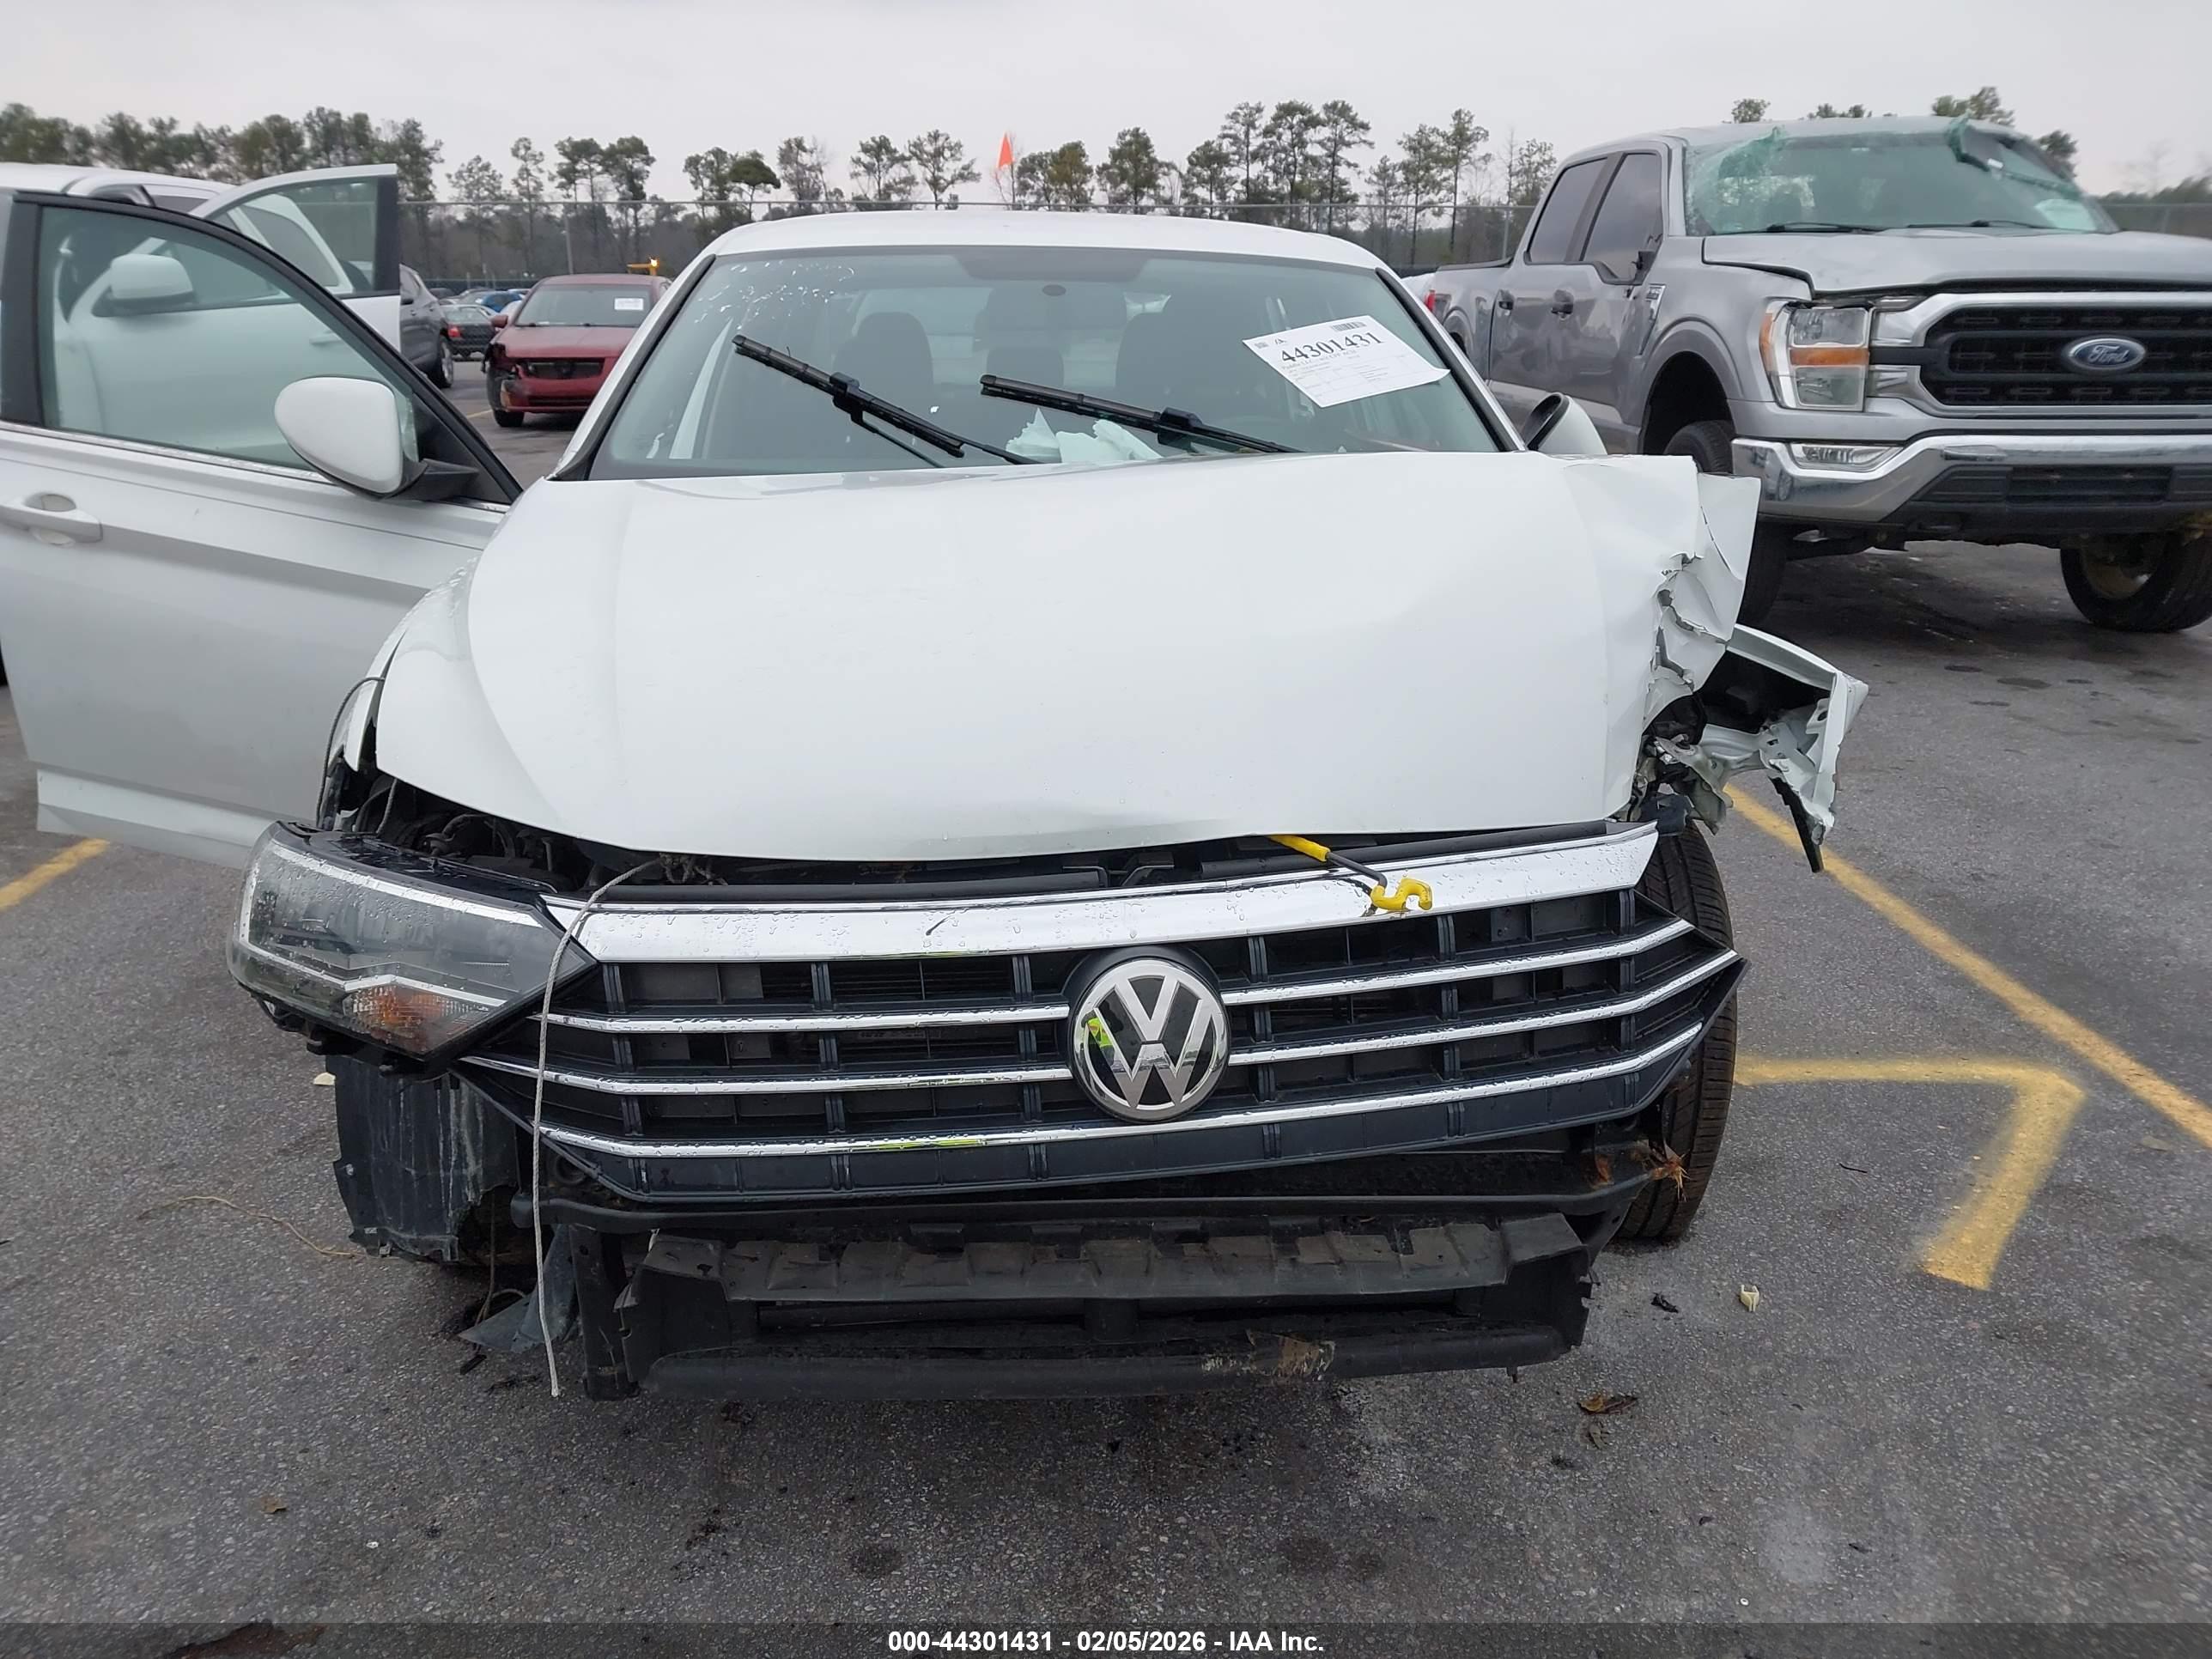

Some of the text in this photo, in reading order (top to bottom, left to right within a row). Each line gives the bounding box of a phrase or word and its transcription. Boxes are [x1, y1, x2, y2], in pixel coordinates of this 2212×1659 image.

[1280, 331, 1383, 362] 44301431
[2087, 343, 2130, 362] Ford
[1082, 967, 1220, 1113] VW
